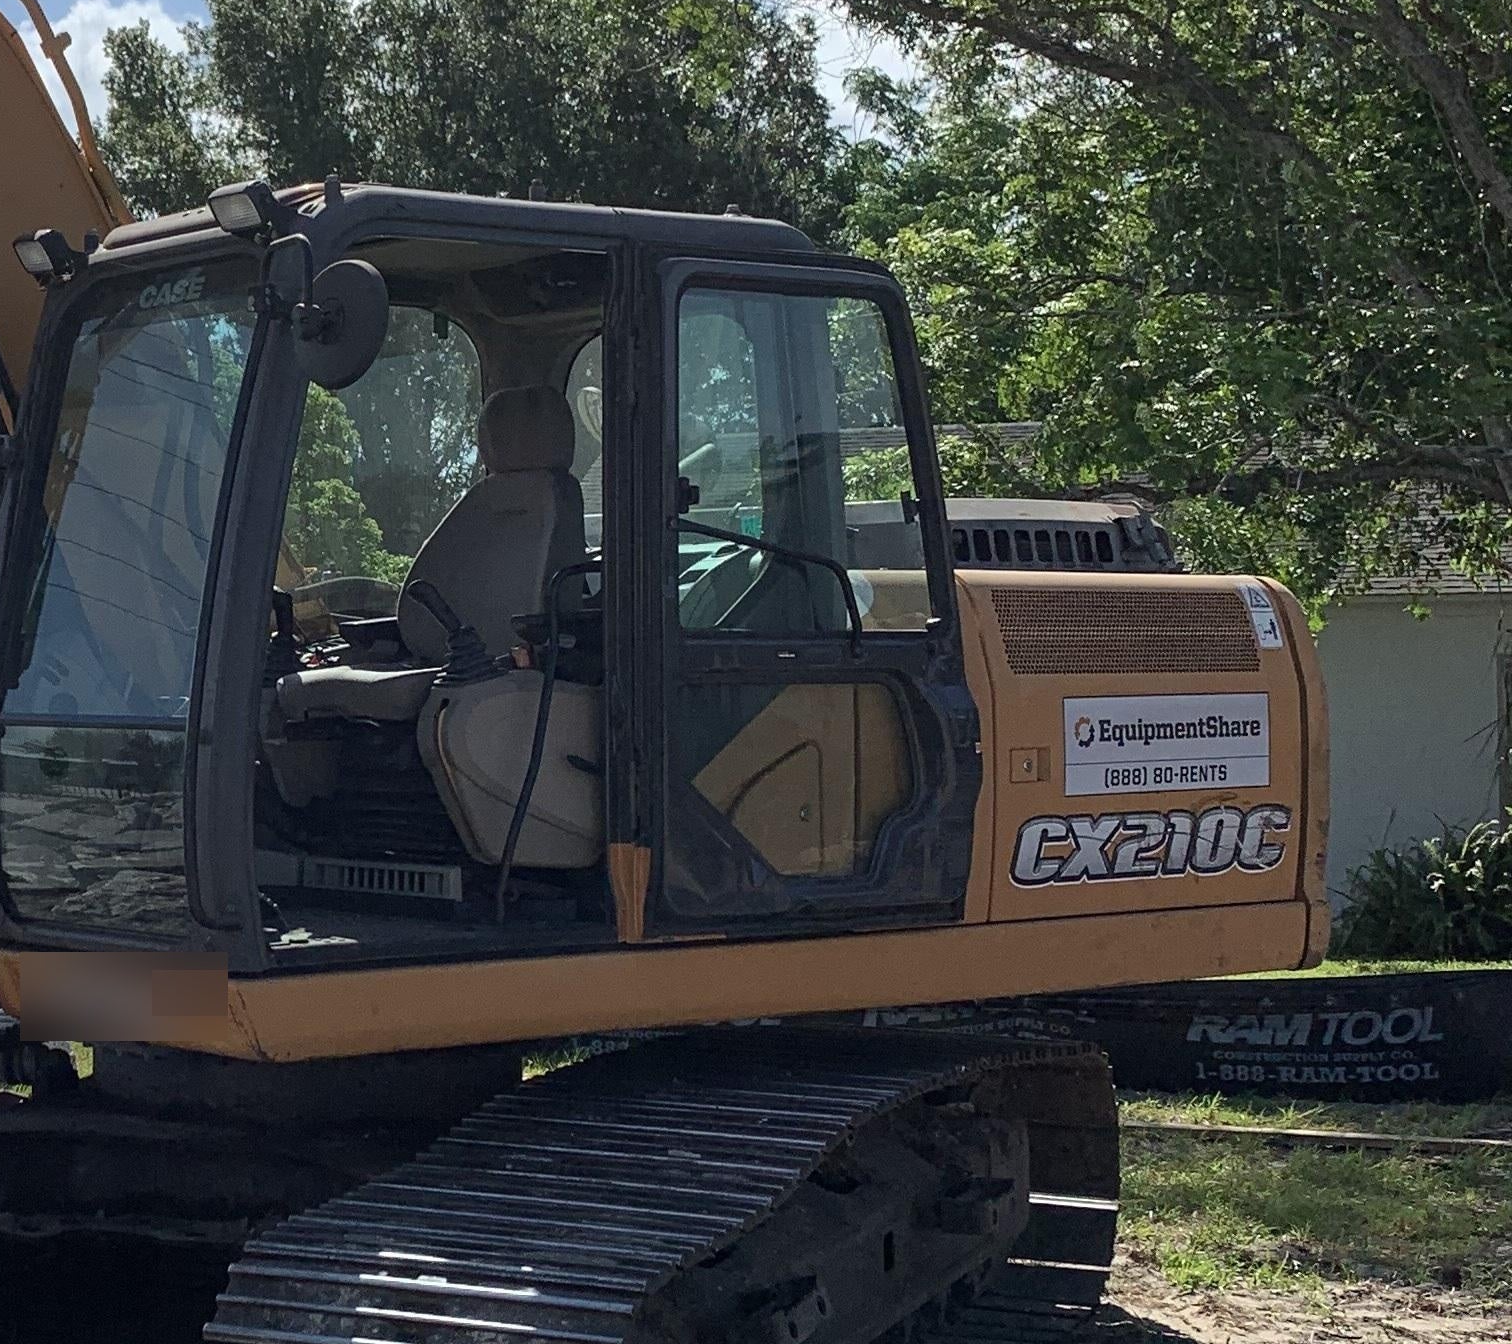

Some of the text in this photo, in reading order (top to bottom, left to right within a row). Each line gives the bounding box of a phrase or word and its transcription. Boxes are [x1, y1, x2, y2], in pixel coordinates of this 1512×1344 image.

[138, 275, 206, 309] CASE
[1098, 715, 1262, 747] EquipmentShare
[1104, 764, 1228, 789] (888) 80-RENTS
[1011, 806, 1291, 885] CX210C
